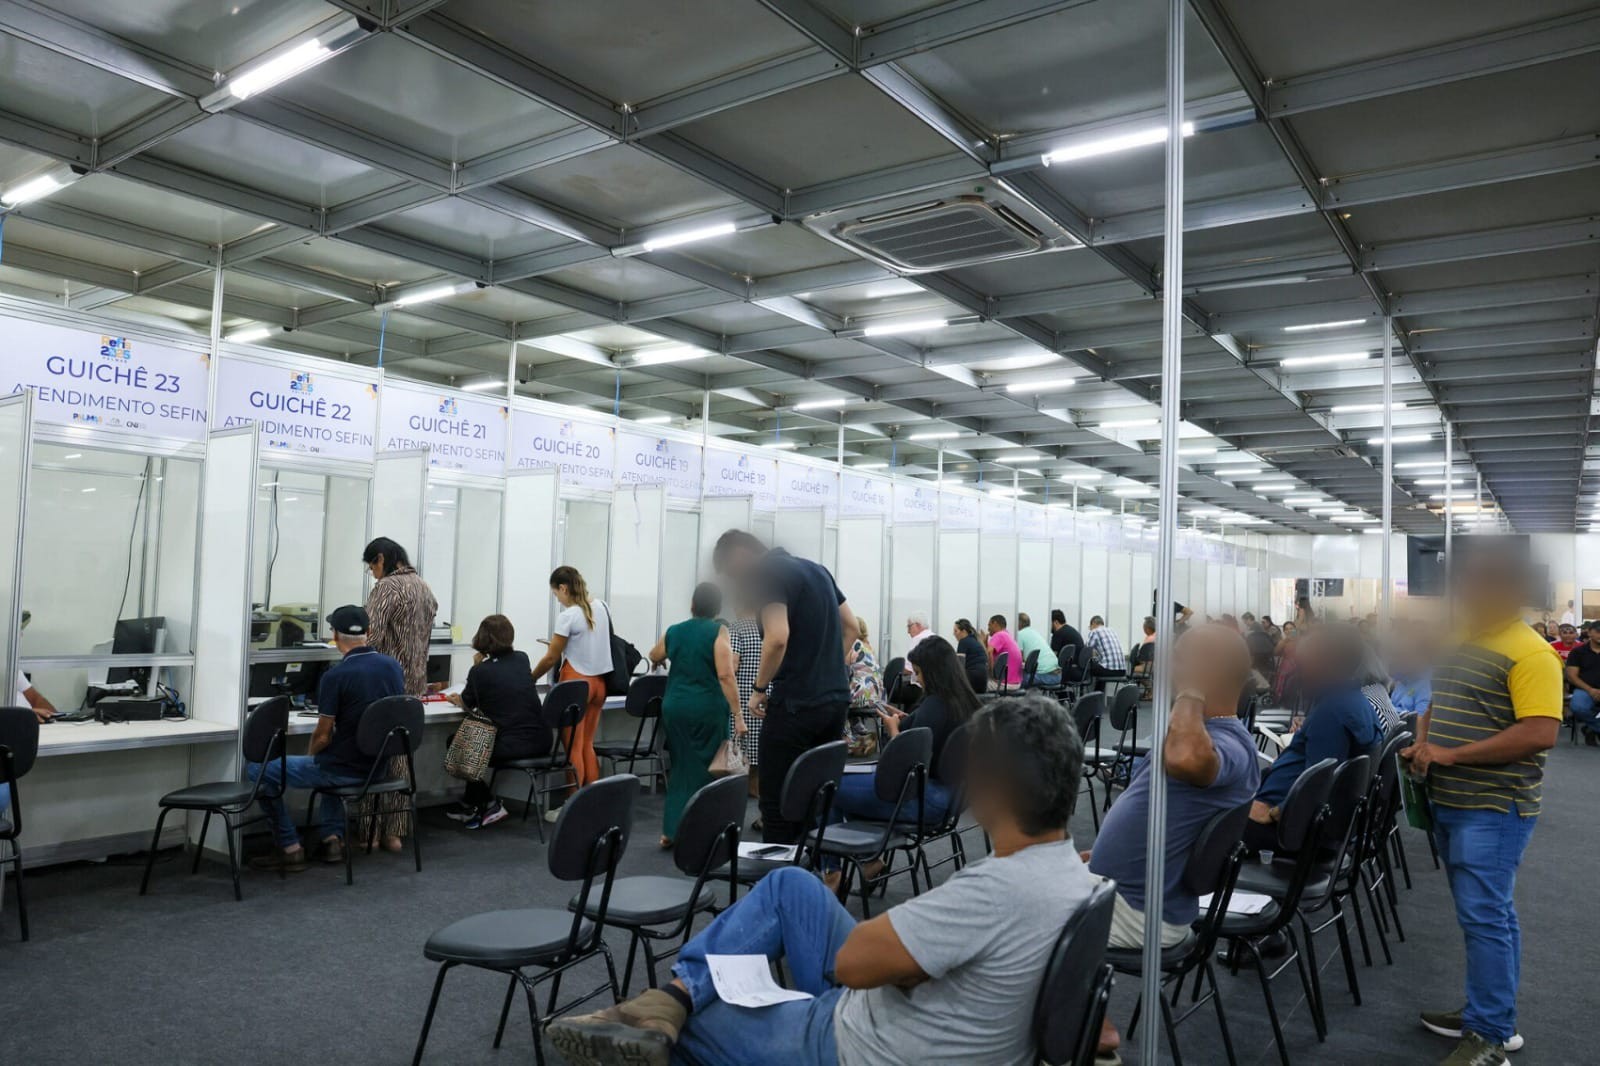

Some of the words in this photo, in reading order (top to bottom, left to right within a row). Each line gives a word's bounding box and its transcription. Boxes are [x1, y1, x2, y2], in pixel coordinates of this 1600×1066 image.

[46, 355, 148, 389] GUICHÊ
[154, 373, 181, 393] 23
[12, 383, 155, 415] ATENDIMENTO
[160, 404, 207, 423] SEFIN
[249, 390, 327, 417] GUICHÊ
[331, 403, 351, 421] 22
[335, 430, 373, 446] SEFIN
[409, 415, 470, 437] GUICHÊ
[473, 424, 487, 439] 21
[474, 448, 505, 461] SEFIN
[533, 436, 583, 456] GUICHÊ
[585, 445, 600, 459] 20
[635, 452, 677, 470] GUICHÊ
[679, 459, 689, 472] 19
[721, 467, 756, 484] GUICHÊ
[757, 473, 766, 485] 18
